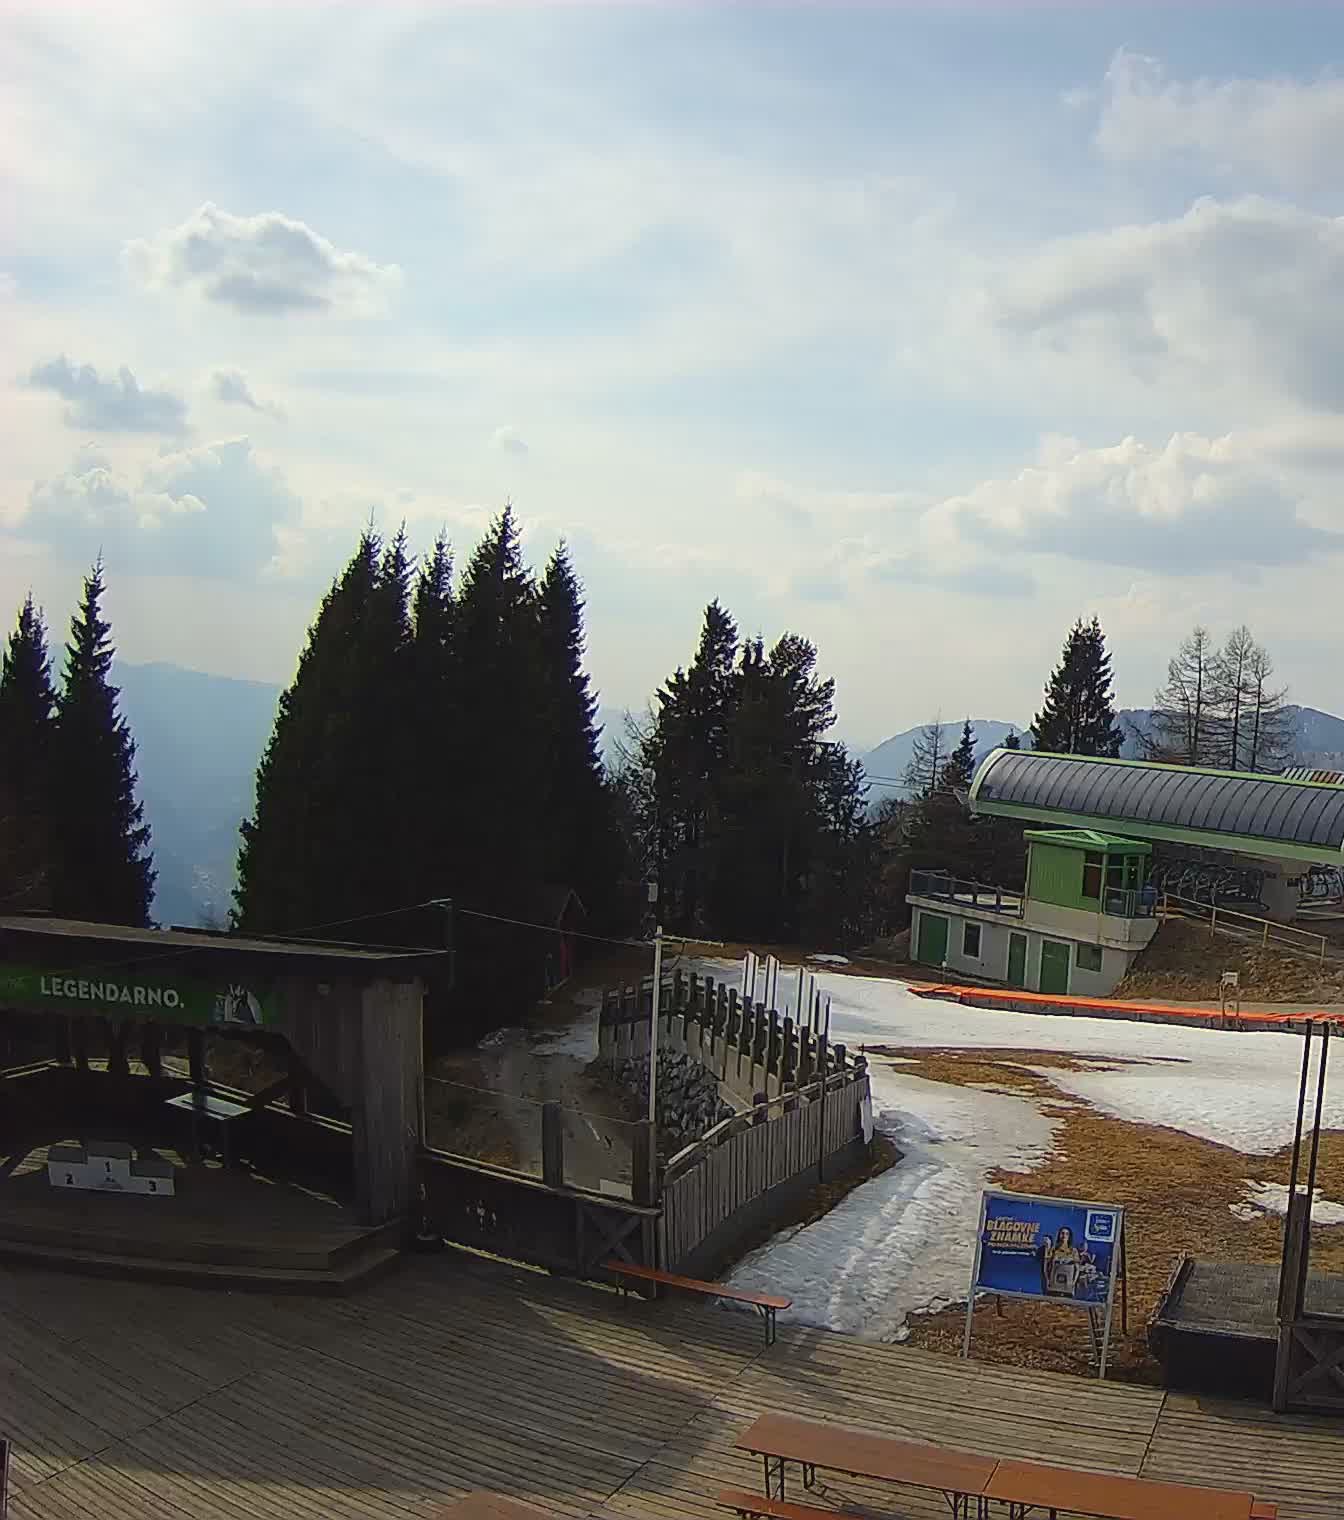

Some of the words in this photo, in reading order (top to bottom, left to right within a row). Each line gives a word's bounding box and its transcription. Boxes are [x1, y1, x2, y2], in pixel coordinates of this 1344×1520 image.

[40, 975, 186, 1008] LEGENDARNO.
[104, 1160, 113, 1173] 1
[65, 1173, 75, 1185] 2
[148, 1180, 158, 1192] 3
[986, 1219, 1041, 1233] BLAGOVNE
[990, 1231, 1036, 1243] ZNAMKE
